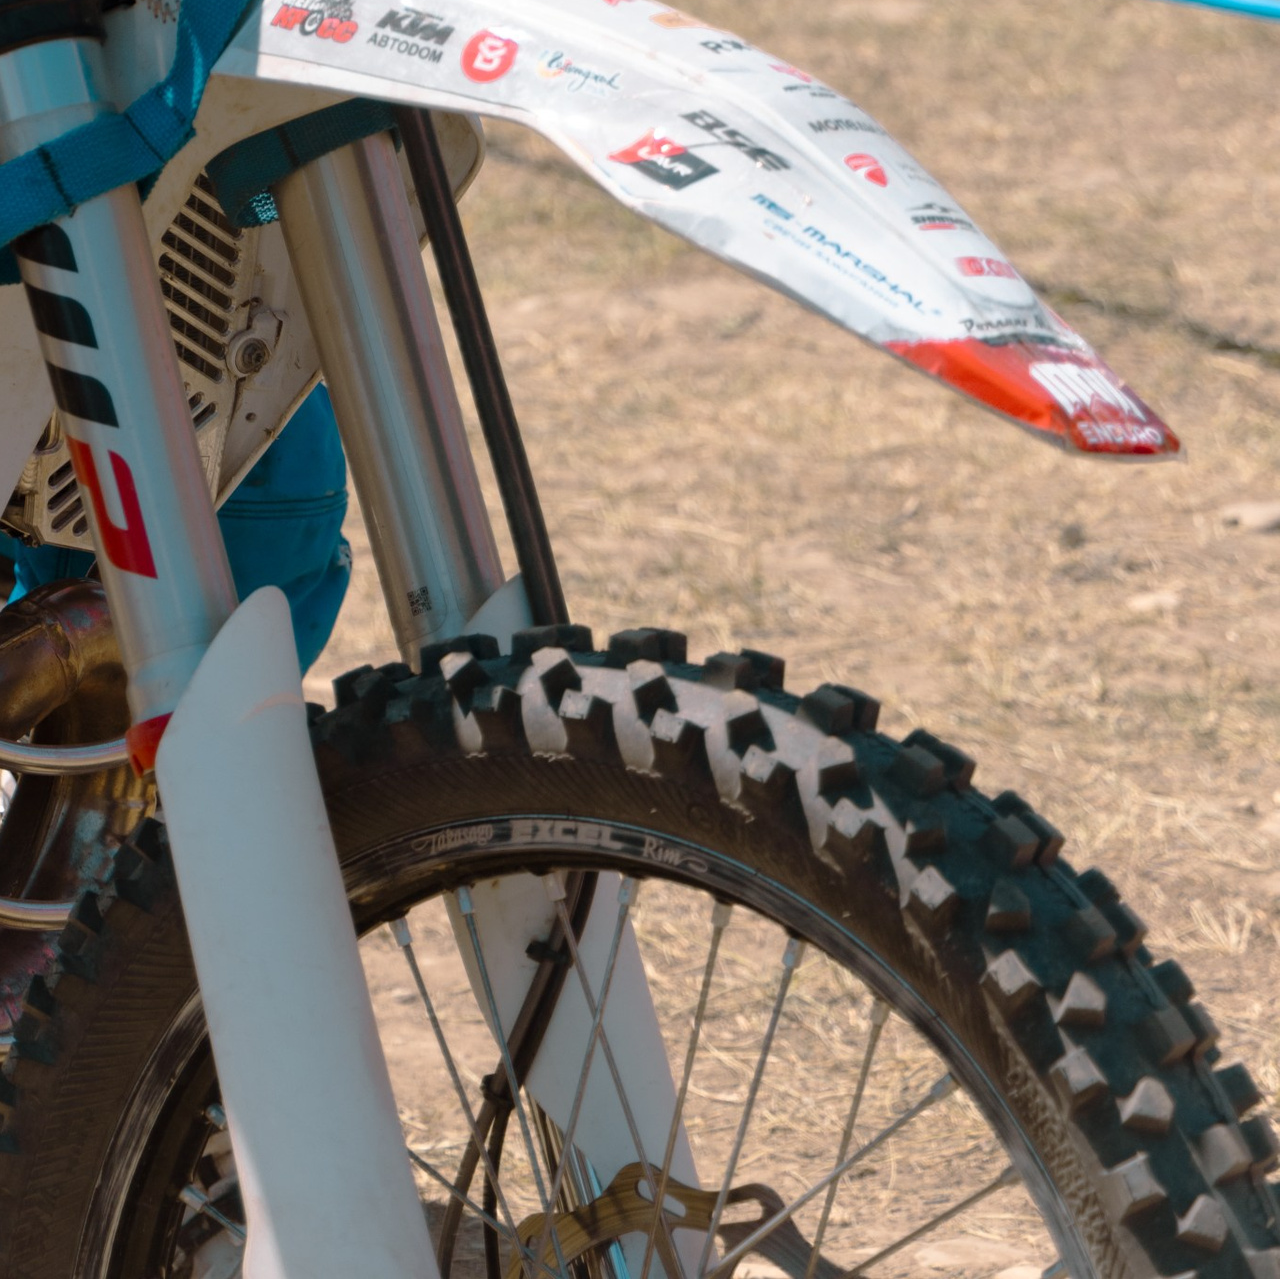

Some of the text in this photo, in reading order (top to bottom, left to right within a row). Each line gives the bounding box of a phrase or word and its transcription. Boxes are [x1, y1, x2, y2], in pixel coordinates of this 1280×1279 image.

[375, 9, 456, 47] KTM
[1077, 420, 1163, 445] ENDURO
[509, 819, 623, 850] EXCEL
